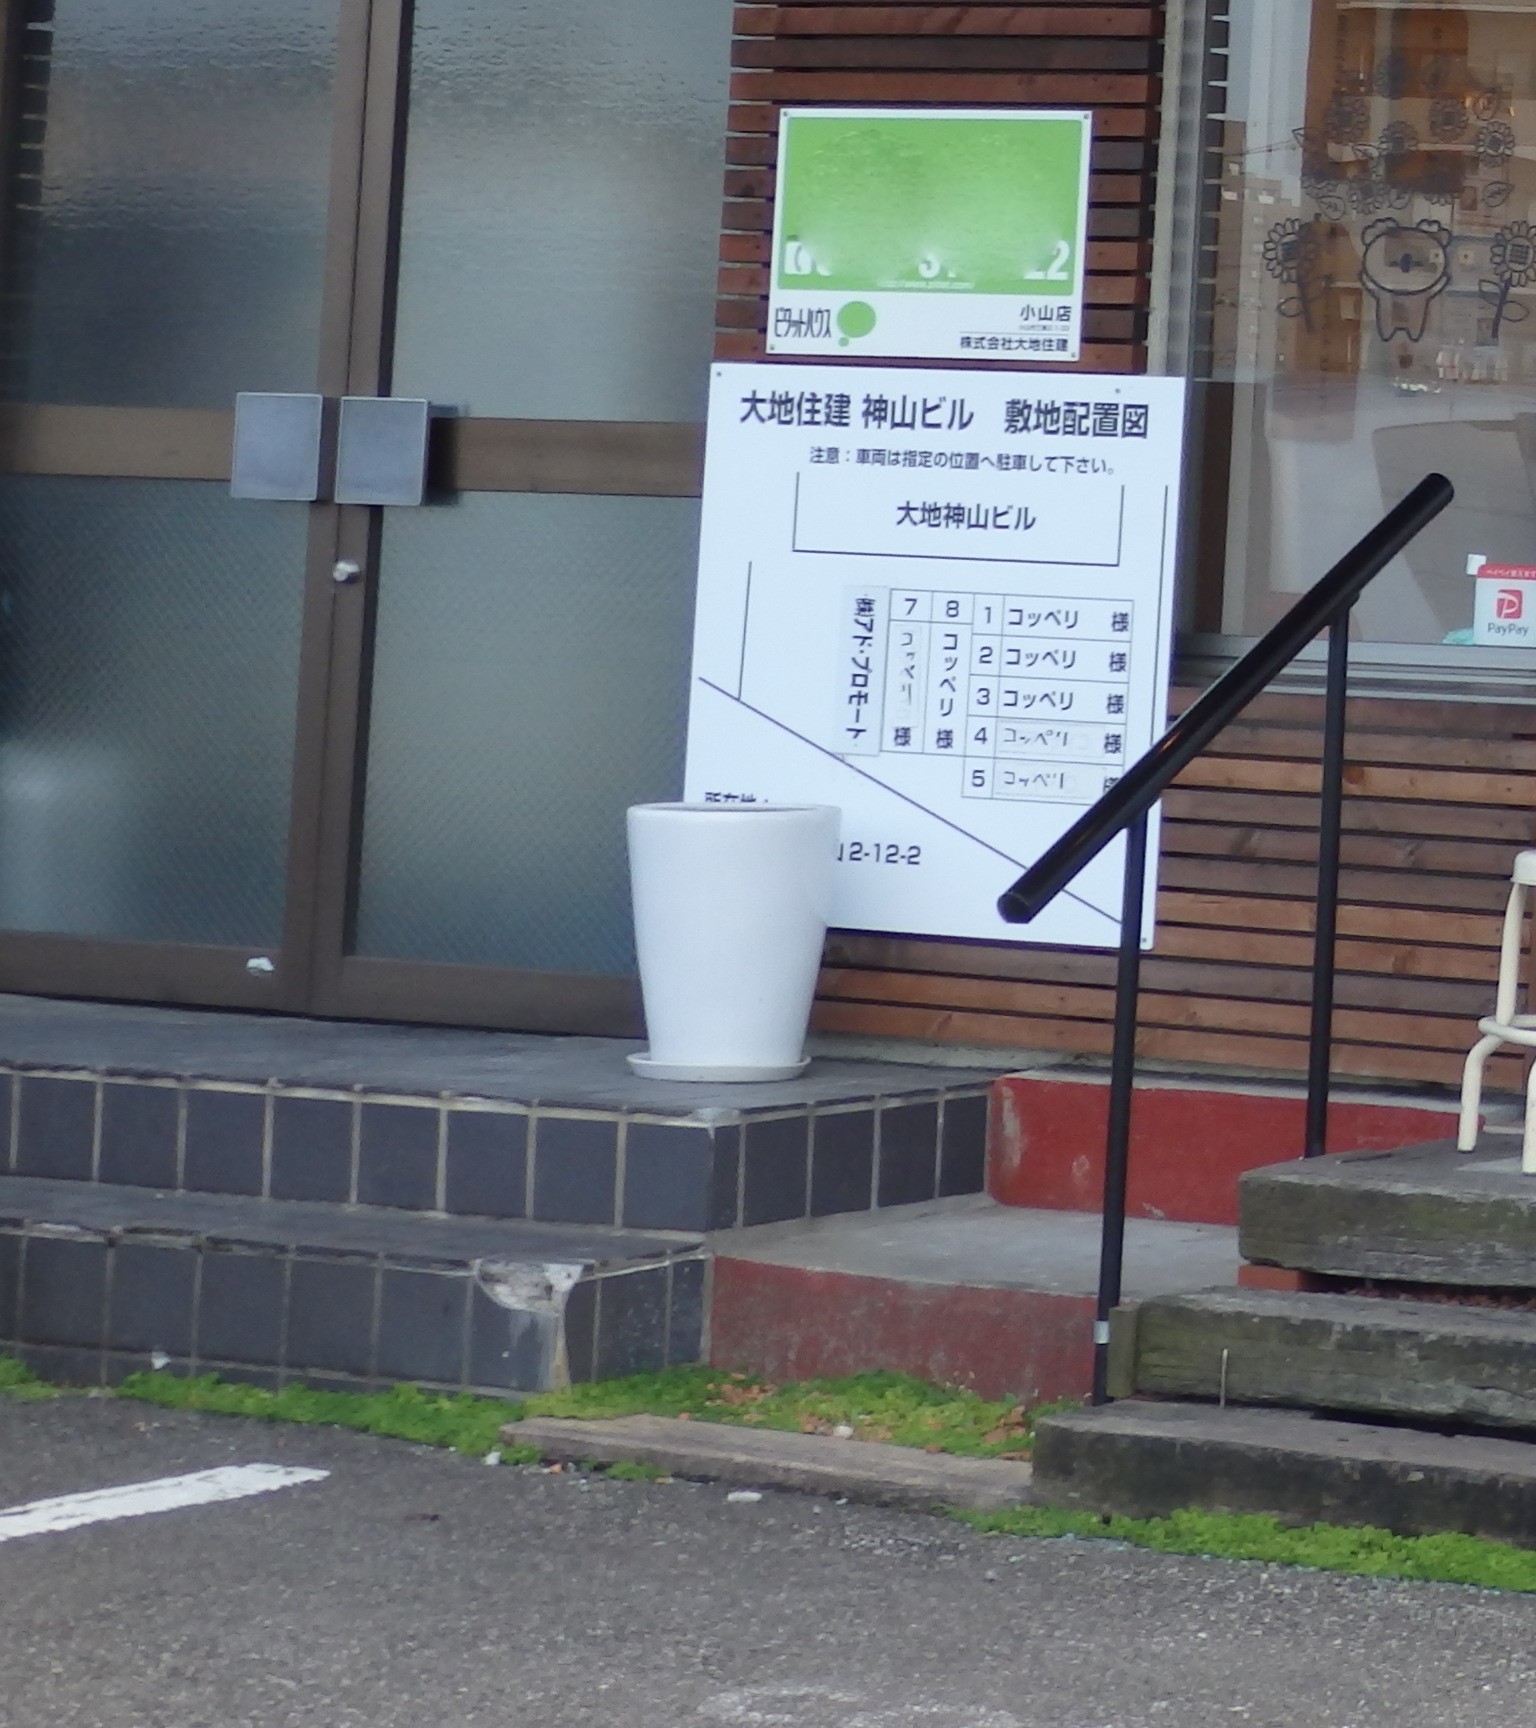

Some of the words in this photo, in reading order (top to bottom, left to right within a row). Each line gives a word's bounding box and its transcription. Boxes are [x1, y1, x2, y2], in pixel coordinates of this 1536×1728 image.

[1020, 304, 1072, 323] 小山店
[960, 336, 1069, 353] 株式会社大地住建
[740, 390, 851, 429] 大地住建
[861, 393, 975, 432] 神山ビル
[1003, 399, 1150, 439] 敷地配置図
[896, 501, 1037, 531] 大地神山ビル
[905, 598, 917, 616] 7
[945, 600, 960, 618] 8
[984, 606, 991, 624] 1
[1111, 611, 1130, 633] 様
[1487, 622, 1530, 637] PayPay
[978, 646, 993, 665] 2
[1109, 651, 1127, 673] 様
[976, 687, 990, 706] 3
[1106, 693, 1125, 715] 様
[974, 727, 988, 745] 4
[1103, 732, 1122, 754] 様
[972, 769, 985, 788] 5
[837, 842, 922, 866] 2-12-2
